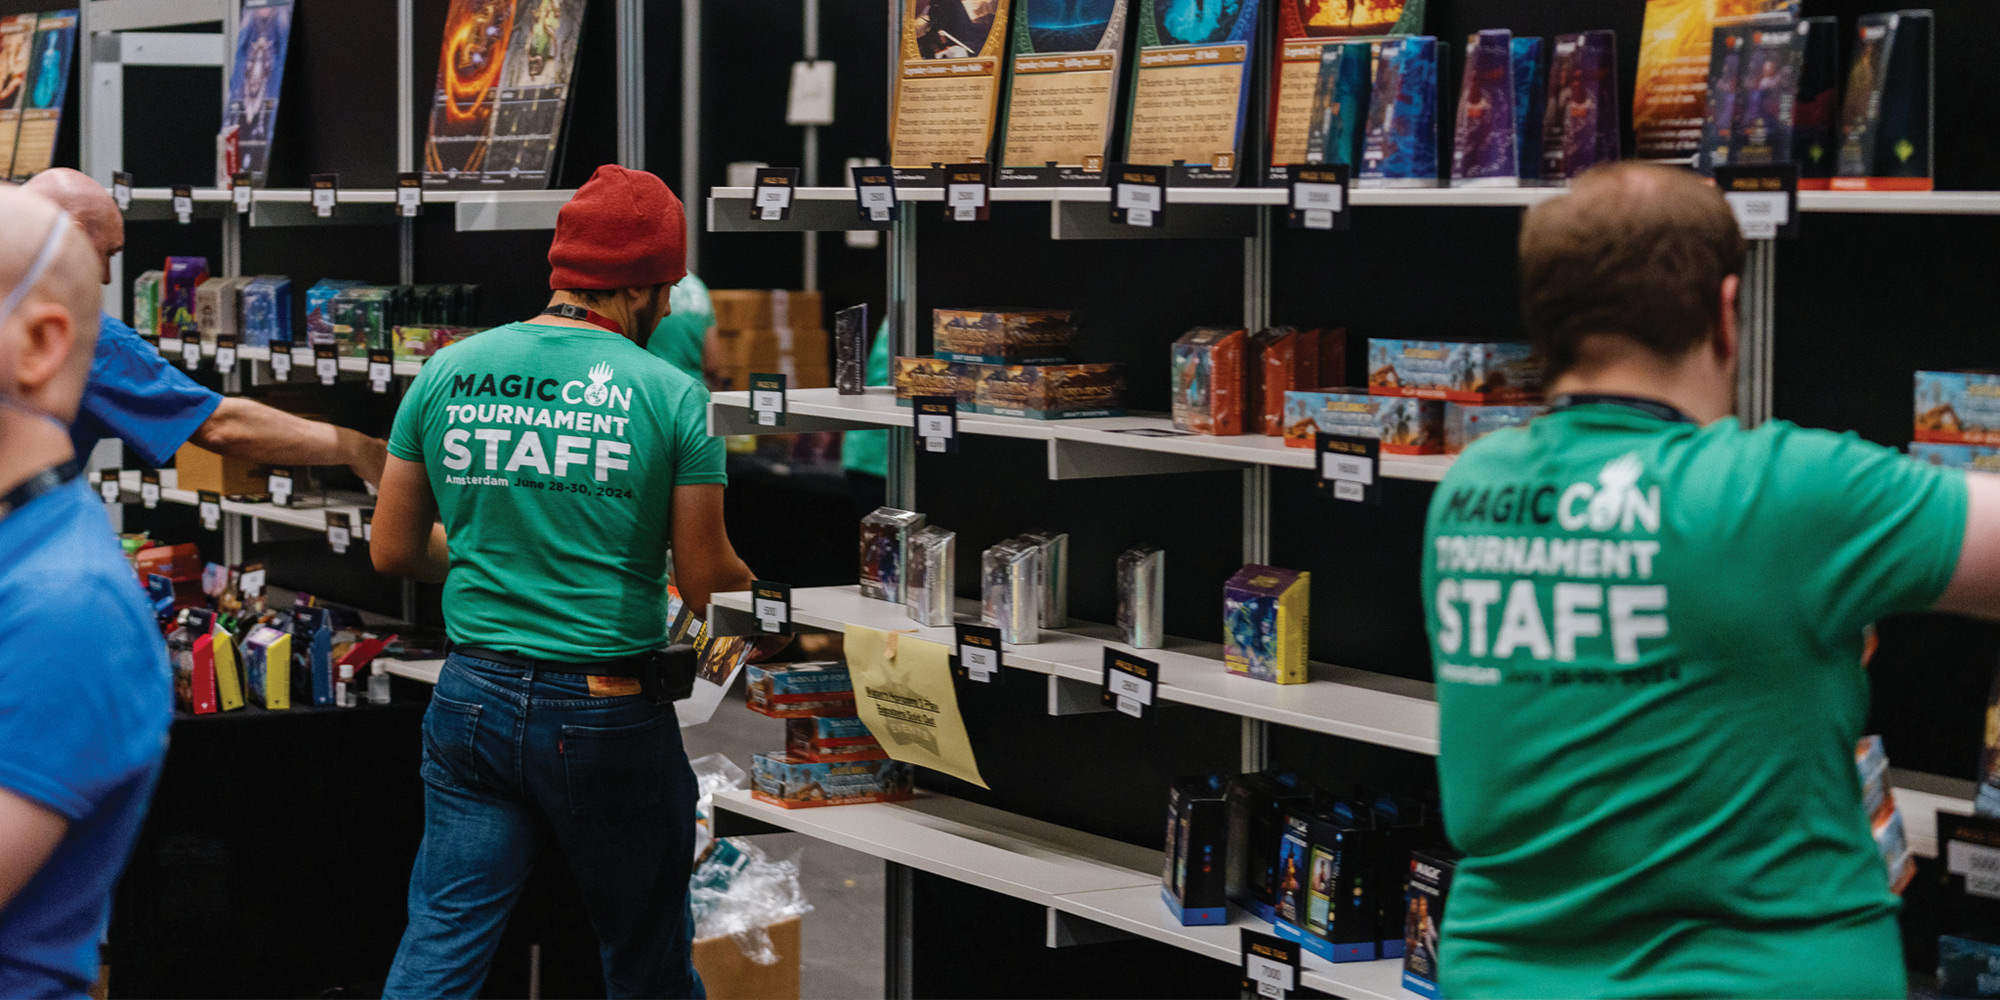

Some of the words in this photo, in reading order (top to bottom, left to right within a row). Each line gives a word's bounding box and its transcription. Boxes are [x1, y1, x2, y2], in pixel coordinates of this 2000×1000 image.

[446, 404, 629, 437] TOURNAMENT
[442, 428, 631, 482] STAFF
[445, 474, 509, 487] Amsterdam
[513, 477, 544, 490] June
[549, 481, 592, 497] 28-30,
[597, 487, 633, 499] 2024
[1435, 535, 1661, 579] TOURNAMENT
[1436, 578, 1669, 664] STAFF
